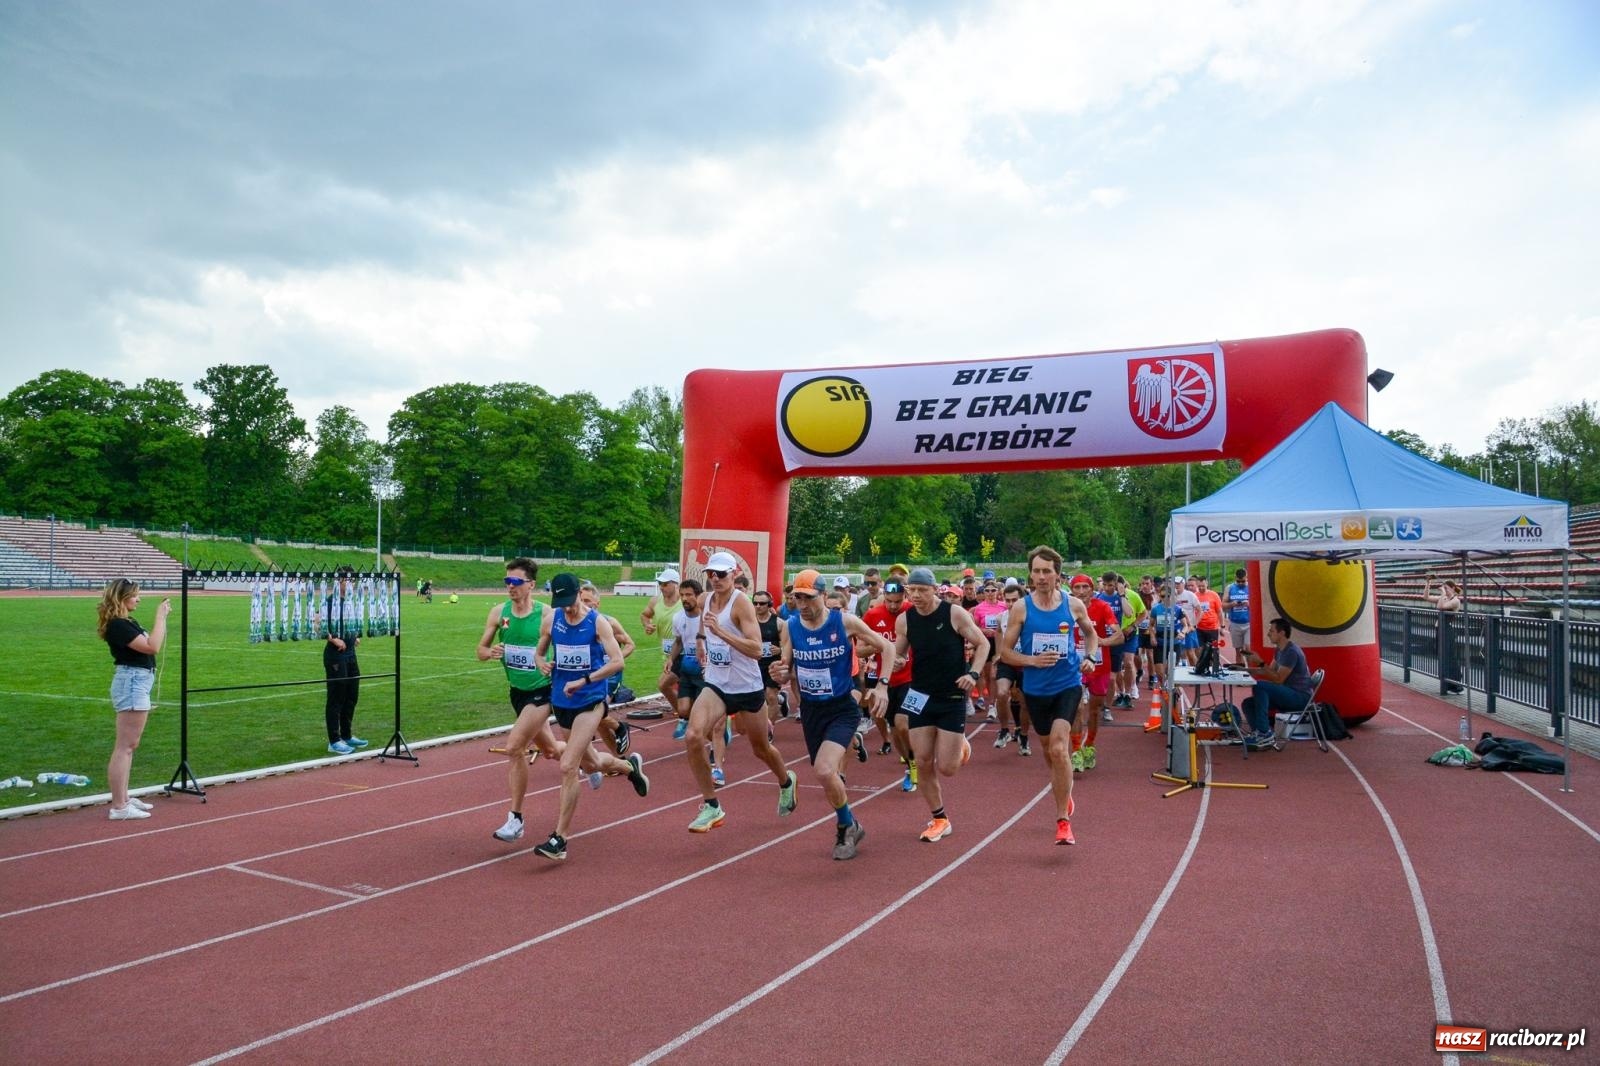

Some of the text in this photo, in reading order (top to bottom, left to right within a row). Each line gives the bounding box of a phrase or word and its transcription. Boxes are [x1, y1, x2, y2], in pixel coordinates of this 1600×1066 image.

[952, 365, 1032, 386] BIEG
[895, 390, 1092, 422] BEZ GRANIC
[914, 423, 1076, 454] RACIBÓRZ
[1196, 521, 1334, 544] PersonalBest
[1504, 527, 1543, 538] MITKO
[1042, 644, 1059, 652] 251
[512, 655, 527, 664] 158
[563, 655, 582, 664] 249
[804, 679, 822, 688] 163
